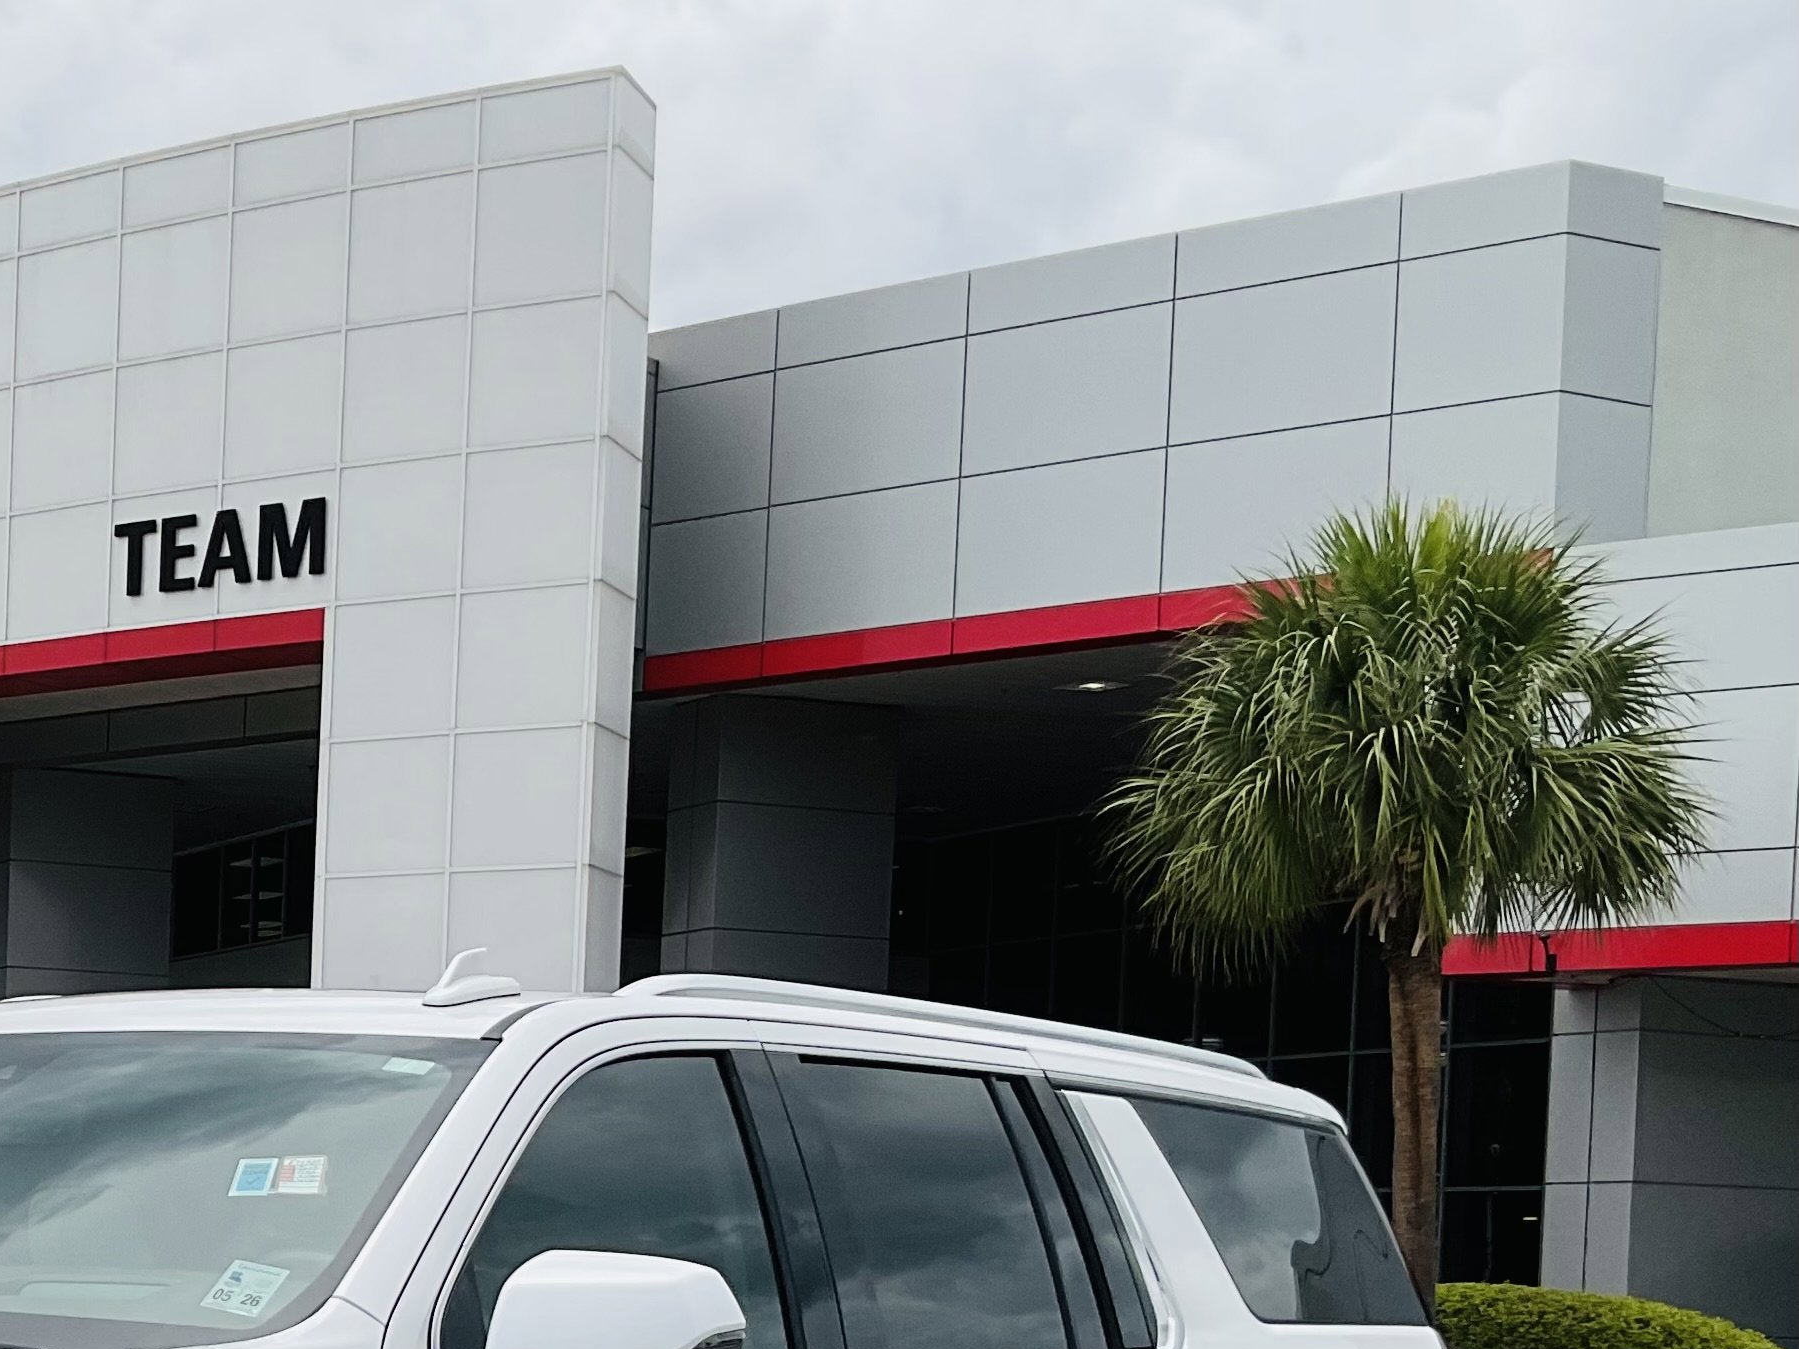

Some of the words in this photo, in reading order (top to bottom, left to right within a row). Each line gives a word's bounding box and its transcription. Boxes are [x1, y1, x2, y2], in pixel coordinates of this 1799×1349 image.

[114, 496, 327, 597] TEAM
[212, 1288, 234, 1302] 05
[240, 1293, 262, 1307] 26
